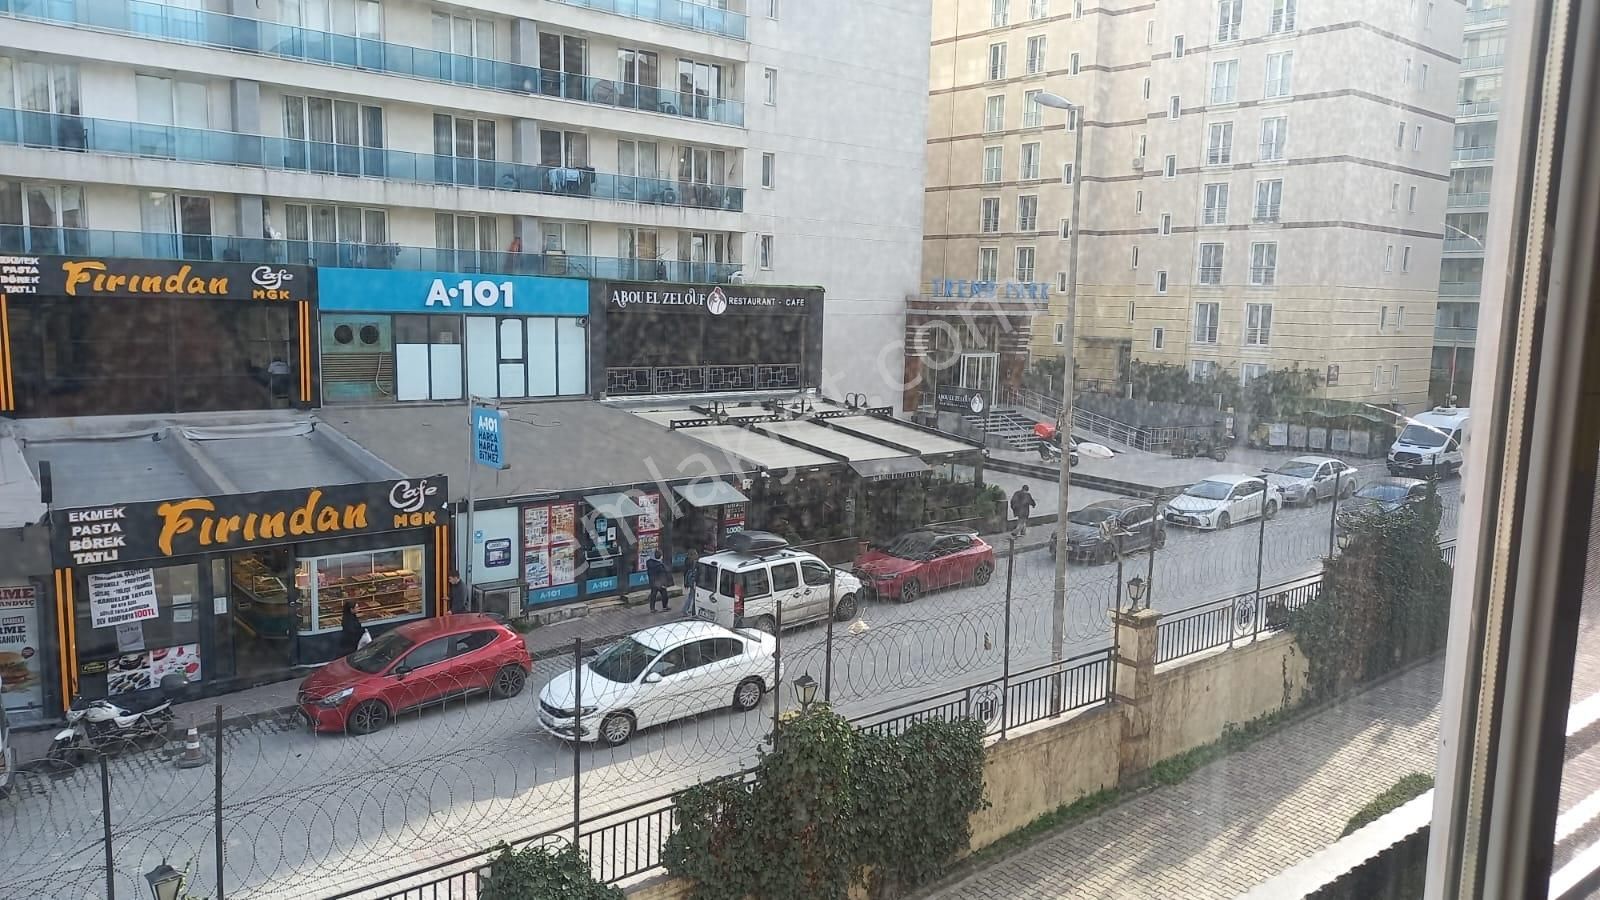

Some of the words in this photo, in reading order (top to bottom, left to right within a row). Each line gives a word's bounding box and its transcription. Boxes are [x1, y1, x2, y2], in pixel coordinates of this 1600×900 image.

[2, 266, 39, 274] PASTA
[251, 265, 294, 290] Cafe
[62, 261, 229, 296] Fırından
[3, 285, 37, 294] TATLI
[253, 289, 290, 299] MGK
[611, 289, 647, 308] ABOU
[646, 291, 661, 304] EL
[728, 296, 776, 306] RESTAURANT
[785, 298, 805, 307] CAFE
[478, 431, 499, 444] HARCA
[478, 440, 499, 454] HARCA
[389, 479, 438, 513] Cafe
[69, 506, 127, 523] EKMEK
[157, 488, 368, 556] Fırından
[393, 511, 436, 529] MGK
[71, 522, 122, 537] PASTA
[69, 534, 127, 552] BÖREK
[73, 549, 119, 565] TATLI
